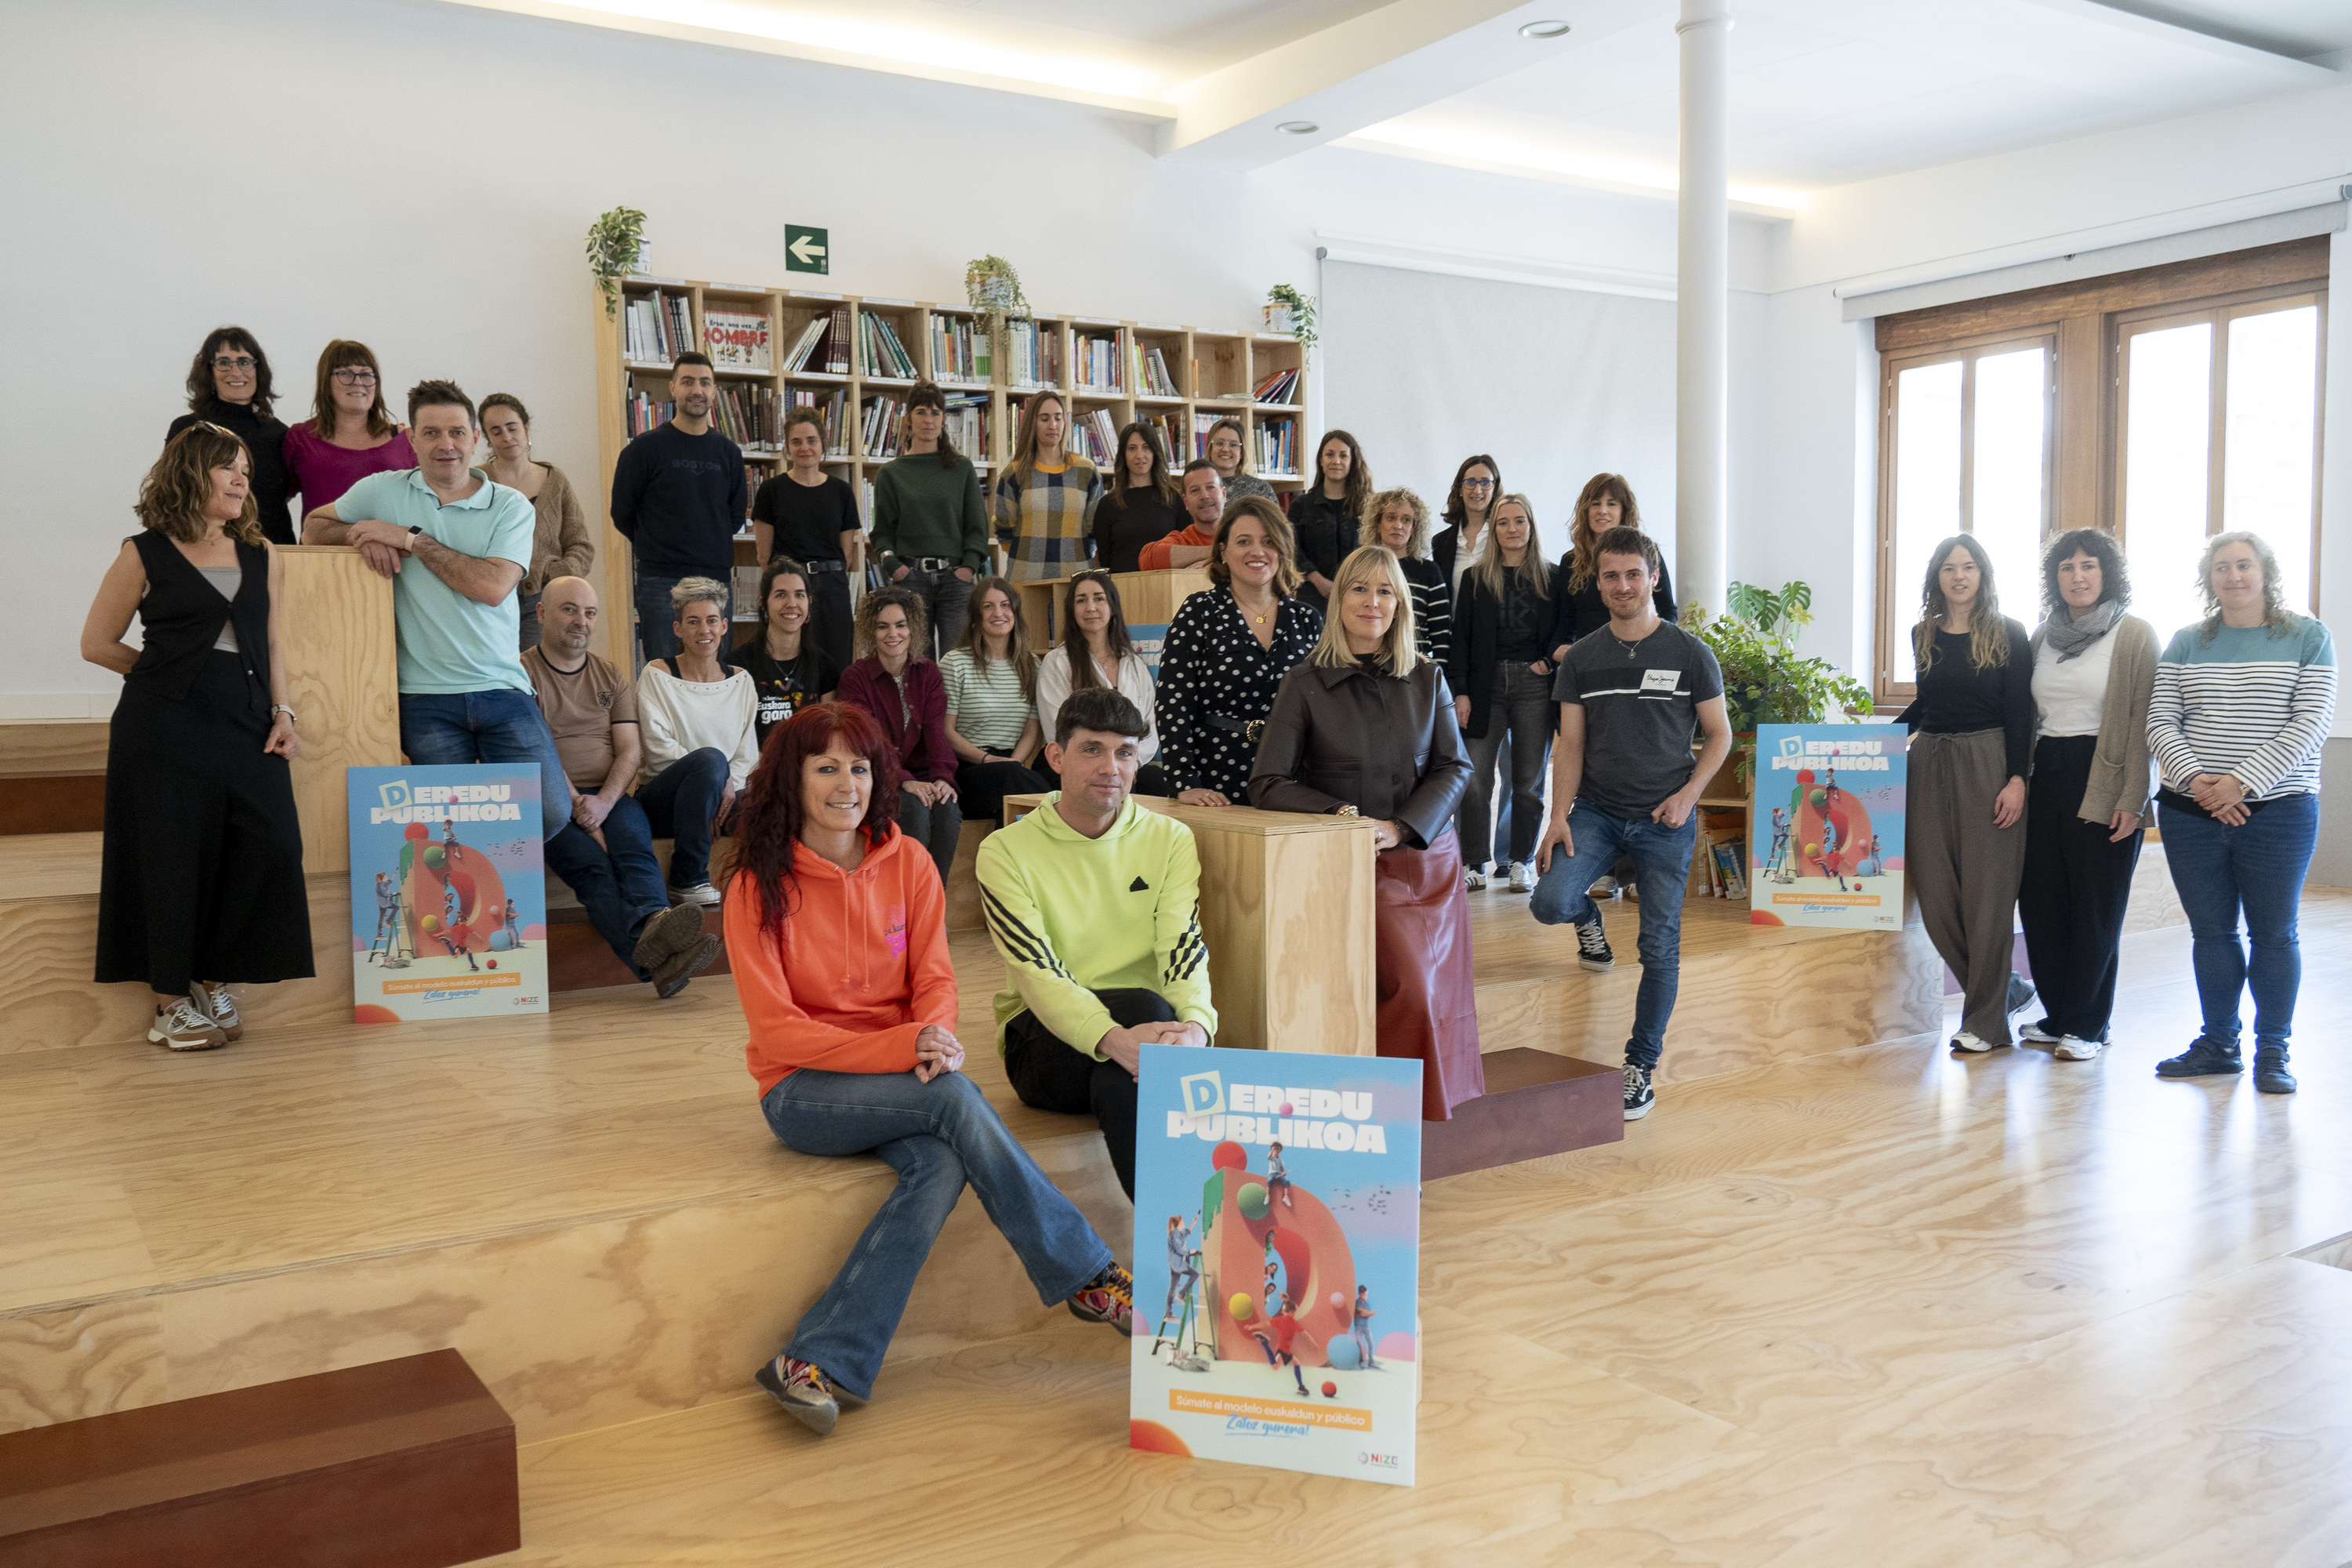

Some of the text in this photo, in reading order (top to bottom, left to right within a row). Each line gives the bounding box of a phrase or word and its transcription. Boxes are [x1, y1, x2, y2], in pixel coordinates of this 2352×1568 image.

[1806, 741, 1882, 755] EREDU
[1771, 757, 1889, 771] PUBLIKOA
[414, 785, 510, 804] EREDU
[370, 804, 521, 824] PUBLIKOA
[1229, 1083, 1373, 1121] EREDU
[1167, 1110, 1388, 1154] PUBLIKOA
[1176, 1394, 1366, 1427] Súmate al modelo euskaldun y público
